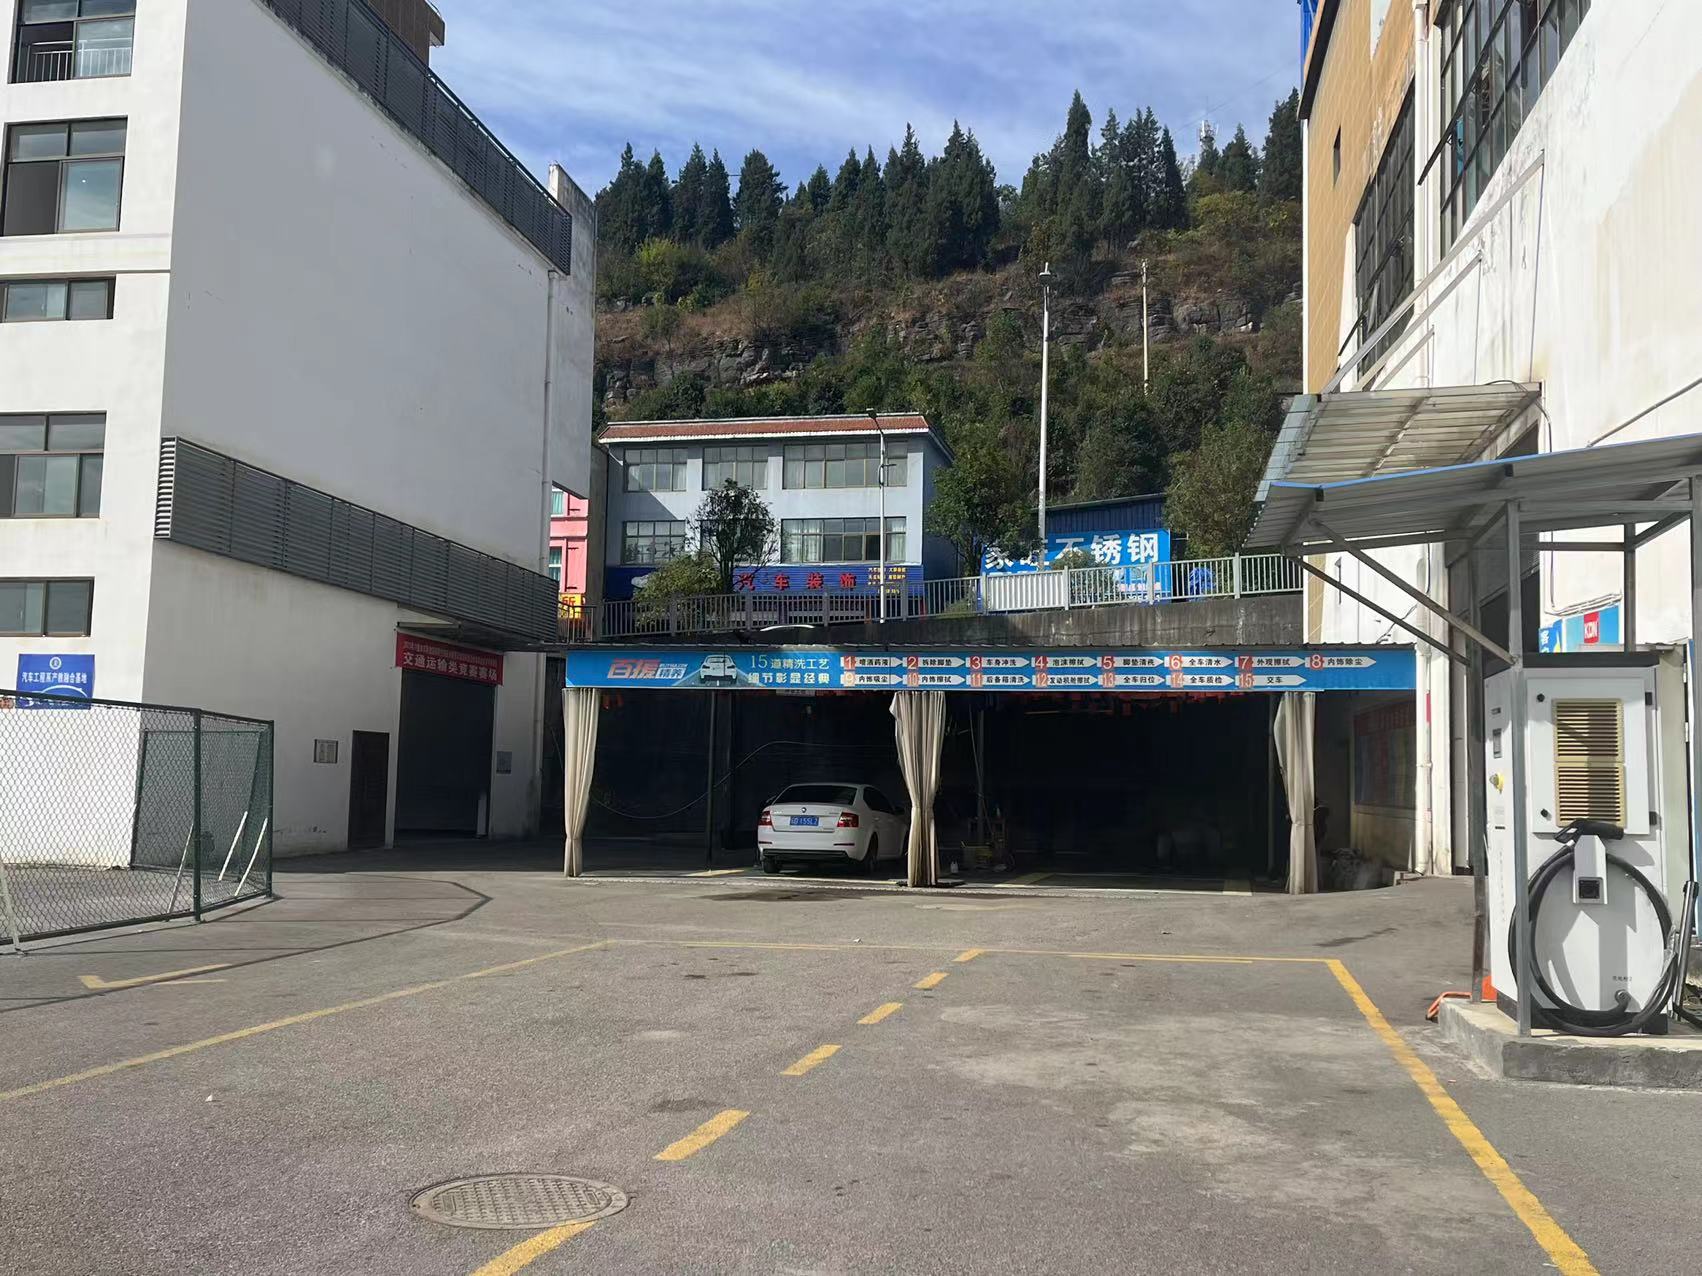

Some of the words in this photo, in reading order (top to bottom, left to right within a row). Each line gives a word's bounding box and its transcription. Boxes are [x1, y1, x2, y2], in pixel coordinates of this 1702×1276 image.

[845, 656, 852, 669] 1
[908, 656, 917, 669] 2
[971, 656, 981, 669] 3
[1035, 656, 1045, 669] 4
[1103, 656, 1112, 669] 5
[1171, 655, 1181, 669] 6
[1240, 656, 1250, 669] 7
[1311, 654, 1321, 668] 8
[1266, 676, 1284, 684] 交车
